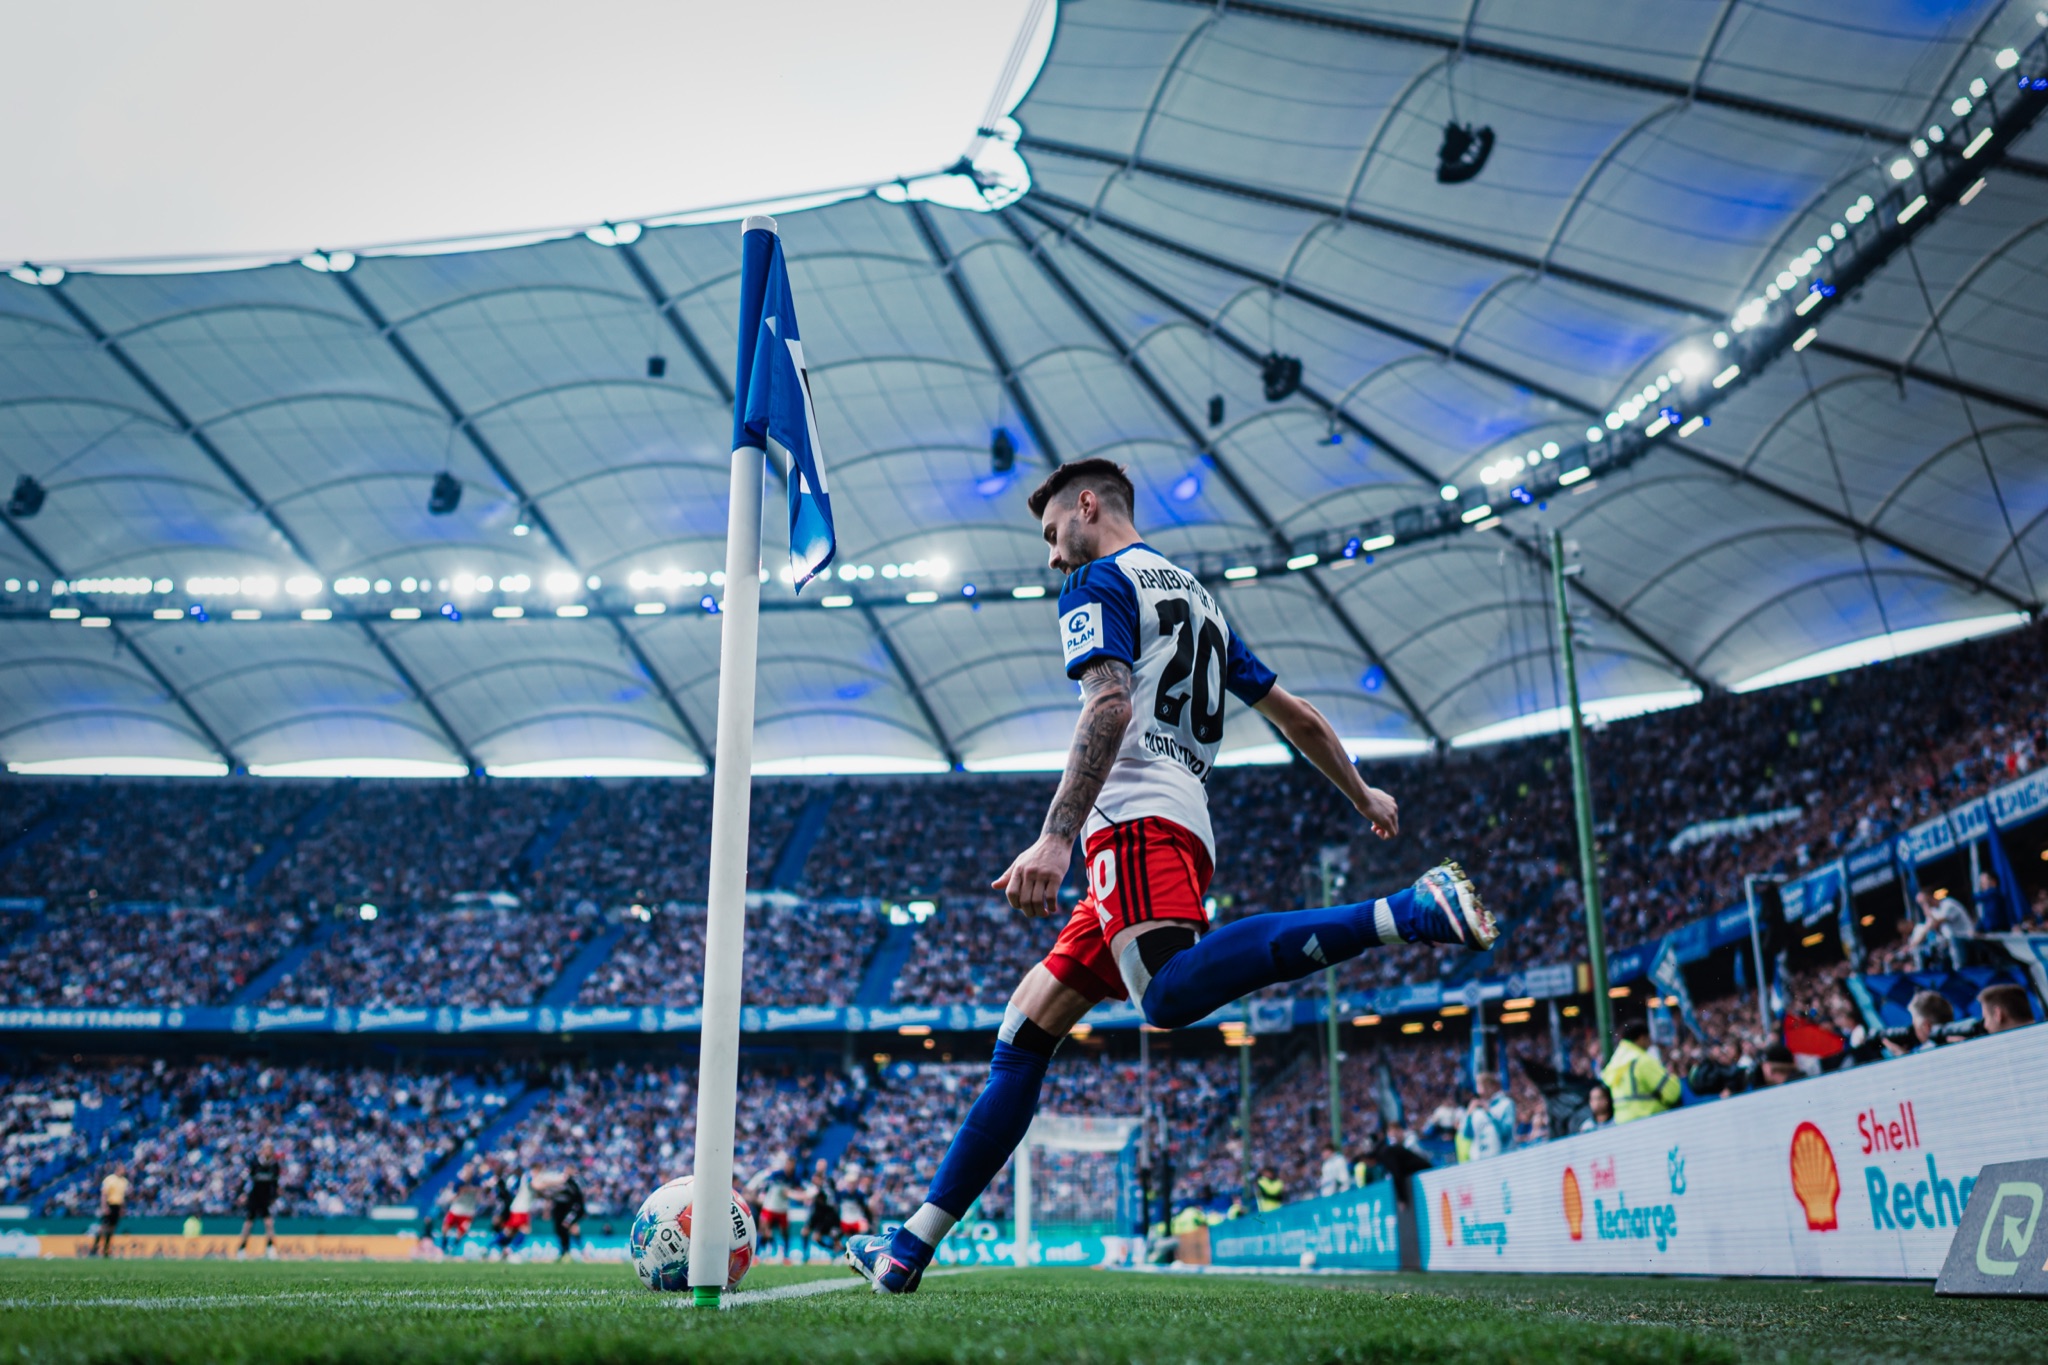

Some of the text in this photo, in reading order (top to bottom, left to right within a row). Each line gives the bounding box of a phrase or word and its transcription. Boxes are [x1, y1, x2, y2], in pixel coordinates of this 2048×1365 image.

[1067, 627, 1095, 650] PLAN
[1154, 598, 1229, 744] 20
[1857, 1101, 1920, 1155] Shell
[1594, 1191, 1678, 1253] Recharge
